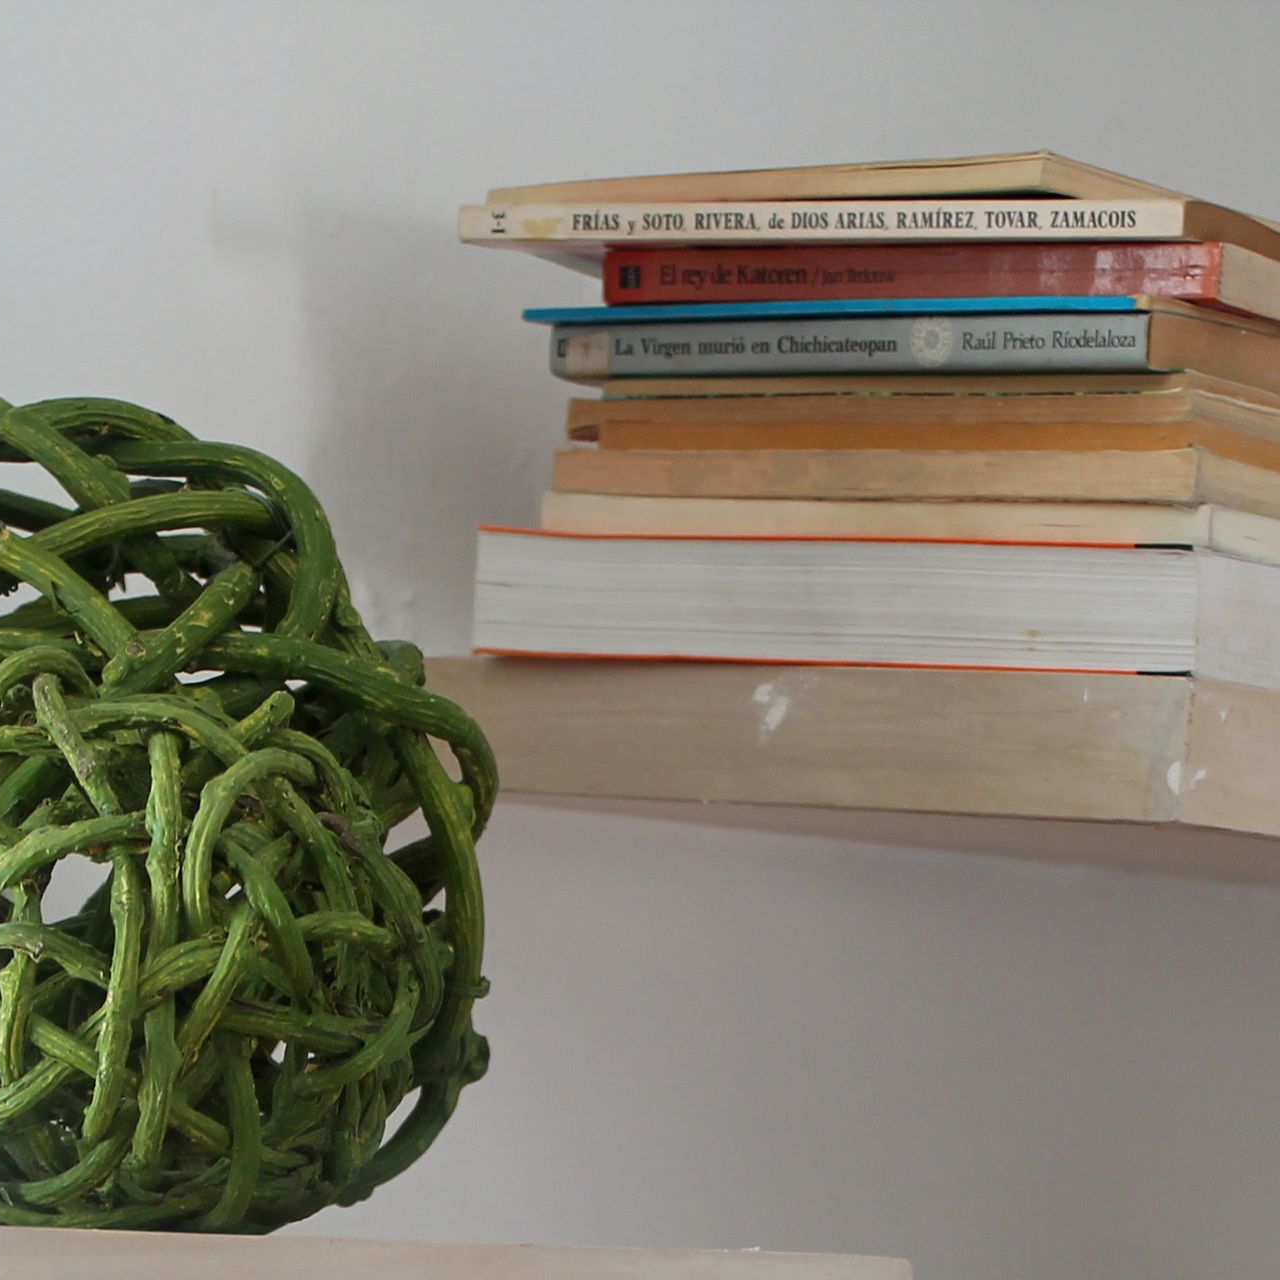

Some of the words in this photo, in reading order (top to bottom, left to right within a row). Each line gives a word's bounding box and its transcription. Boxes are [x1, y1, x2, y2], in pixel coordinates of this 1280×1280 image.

[572, 210, 620, 232] FRÍAS
[627, 220, 636, 236] y
[767, 212, 785, 230] de
[790, 211, 829, 230] DIOS
[1050, 210, 1137, 229] ZAMACOIS
[659, 264, 676, 286] El
[682, 268, 707, 290] rey
[710, 263, 732, 286] de
[615, 338, 634, 356] La
[640, 338, 691, 358] Virgen
[697, 338, 745, 356] murió
[751, 341, 770, 355] en
[777, 335, 898, 357] Chichicateopan
[962, 331, 997, 351] Raúl
[1002, 331, 1046, 351] Prieto
